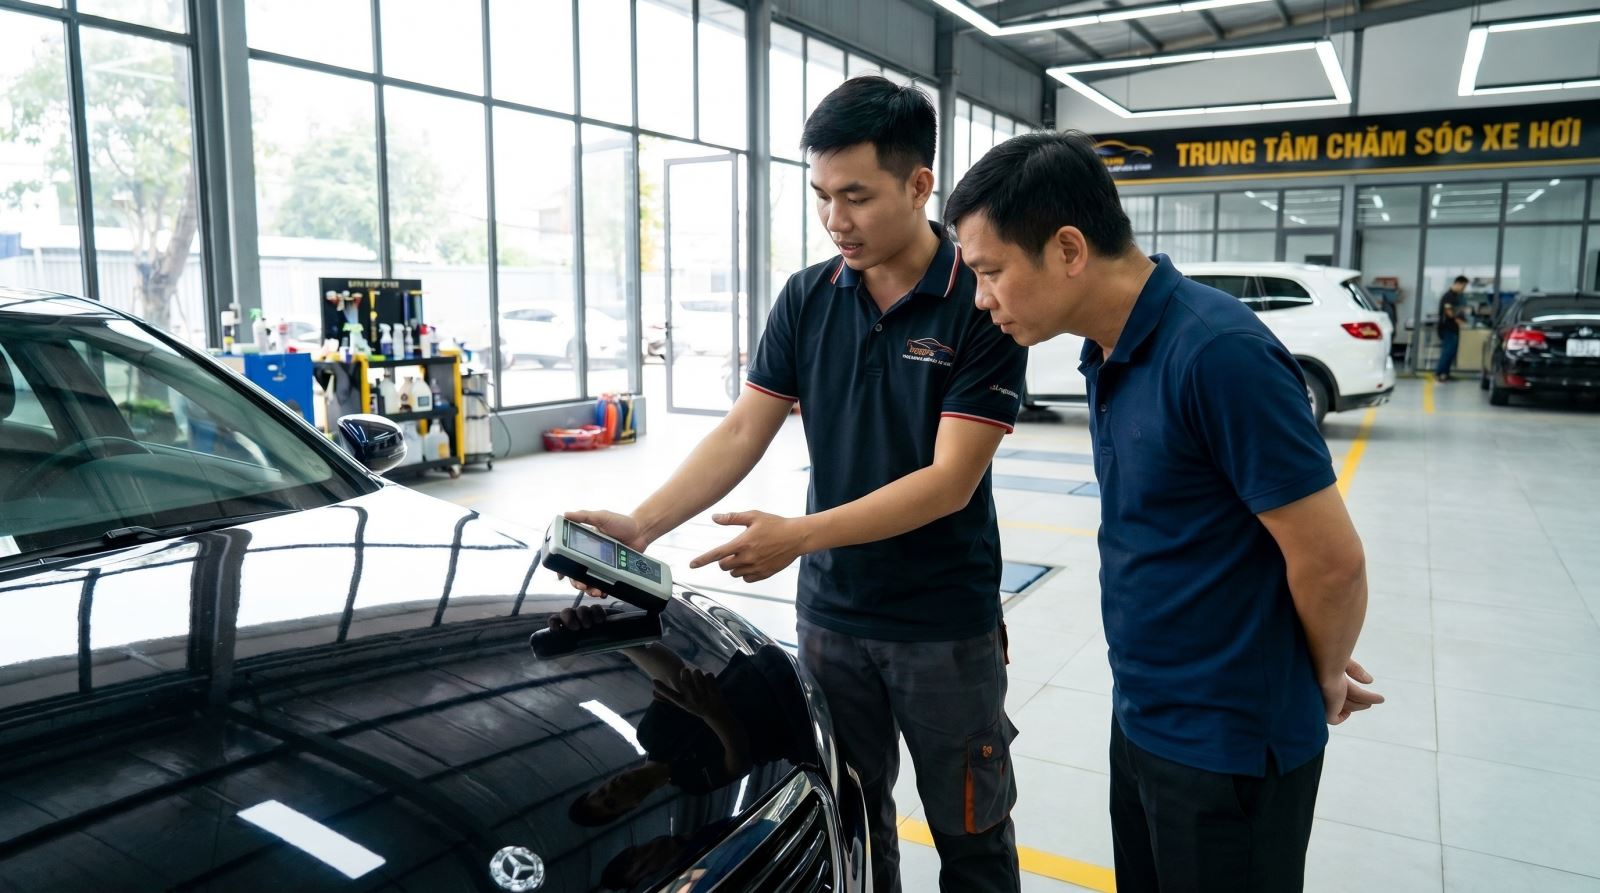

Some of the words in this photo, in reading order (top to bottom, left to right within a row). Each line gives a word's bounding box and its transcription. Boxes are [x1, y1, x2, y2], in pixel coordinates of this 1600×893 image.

[1176, 138, 1256, 167] TRUNG
[1263, 131, 1318, 162] TÂM
[1326, 125, 1407, 160] CHĂM
[1414, 121, 1473, 156] SÓC
[1481, 122, 1520, 151] XE
[1528, 117, 1582, 149] HƠI
